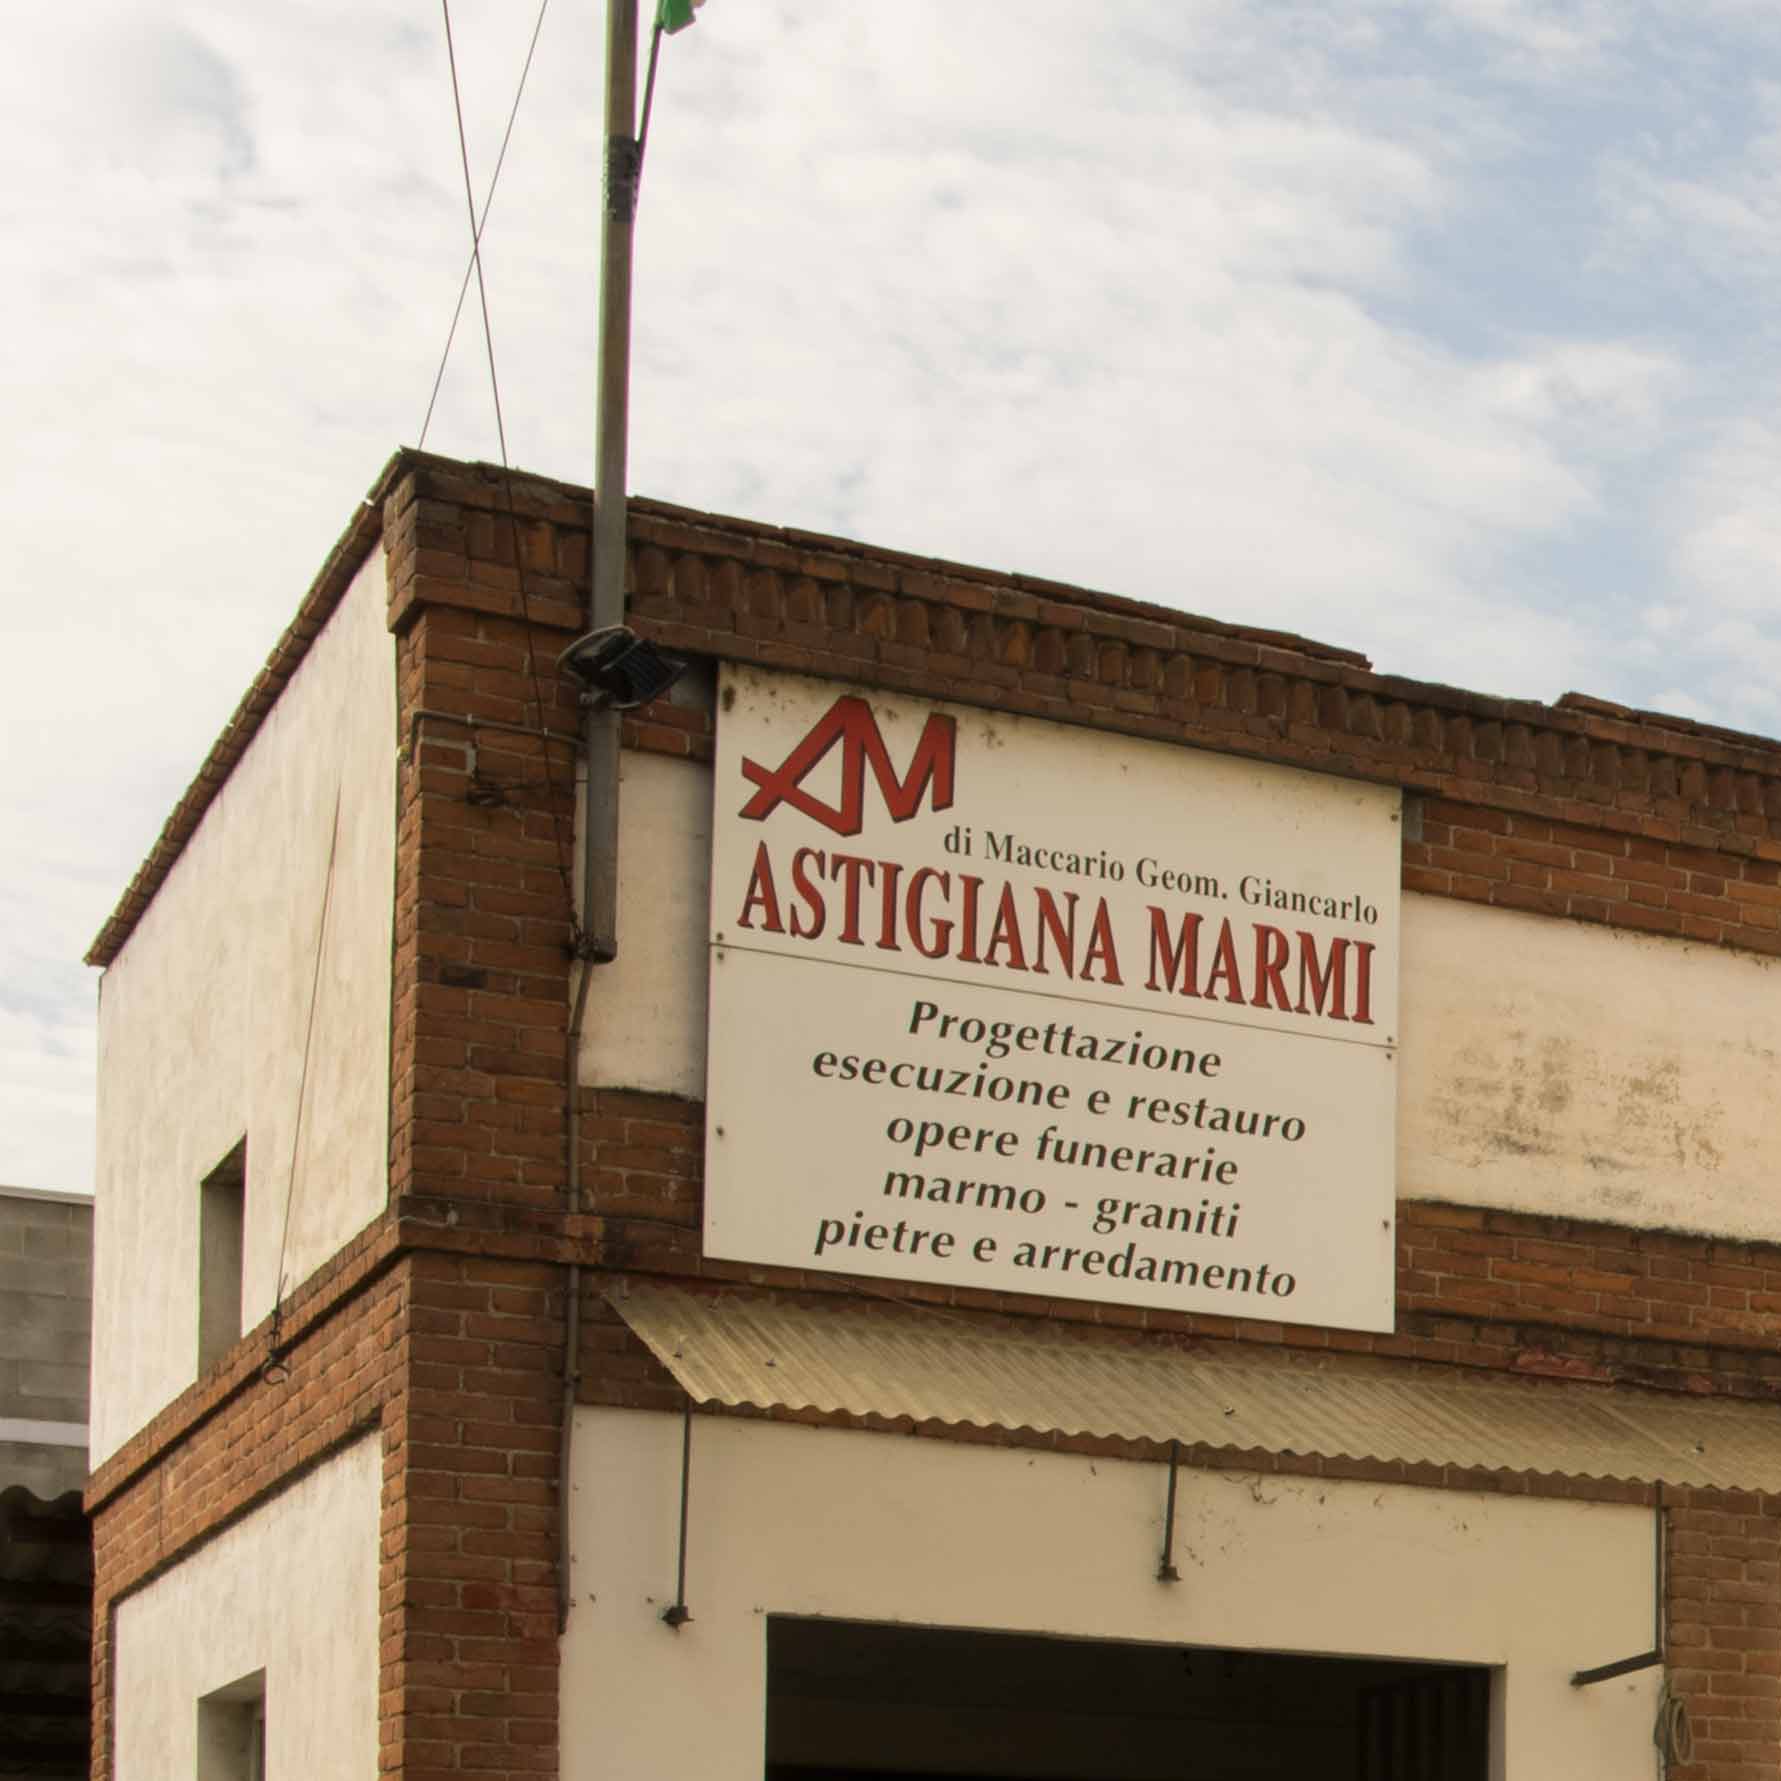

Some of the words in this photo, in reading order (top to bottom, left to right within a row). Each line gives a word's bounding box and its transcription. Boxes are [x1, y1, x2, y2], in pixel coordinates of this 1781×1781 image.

[944, 825, 972, 857] di
[984, 831, 1126, 882] Maccario
[1136, 857, 1229, 900] Geom.
[1239, 875, 1379, 926] Giancarlo
[736, 839, 1125, 987] ASTIGIANA
[1144, 904, 1377, 1026] MARMI
[908, 1000, 1222, 1078] Progettazione
[812, 1050, 1071, 1110] esecuzione
[1087, 1088, 1112, 1115] e
[1127, 1094, 1306, 1152] restauro
[886, 1117, 1019, 1157] opere
[1035, 1124, 1239, 1186] funerarie
[883, 1170, 1047, 1215] marmo
[1092, 1198, 1241, 1249] graniti
[814, 1210, 956, 1258] pietre
[972, 1236, 998, 1263] e
[1012, 1241, 1297, 1297] arredamento
